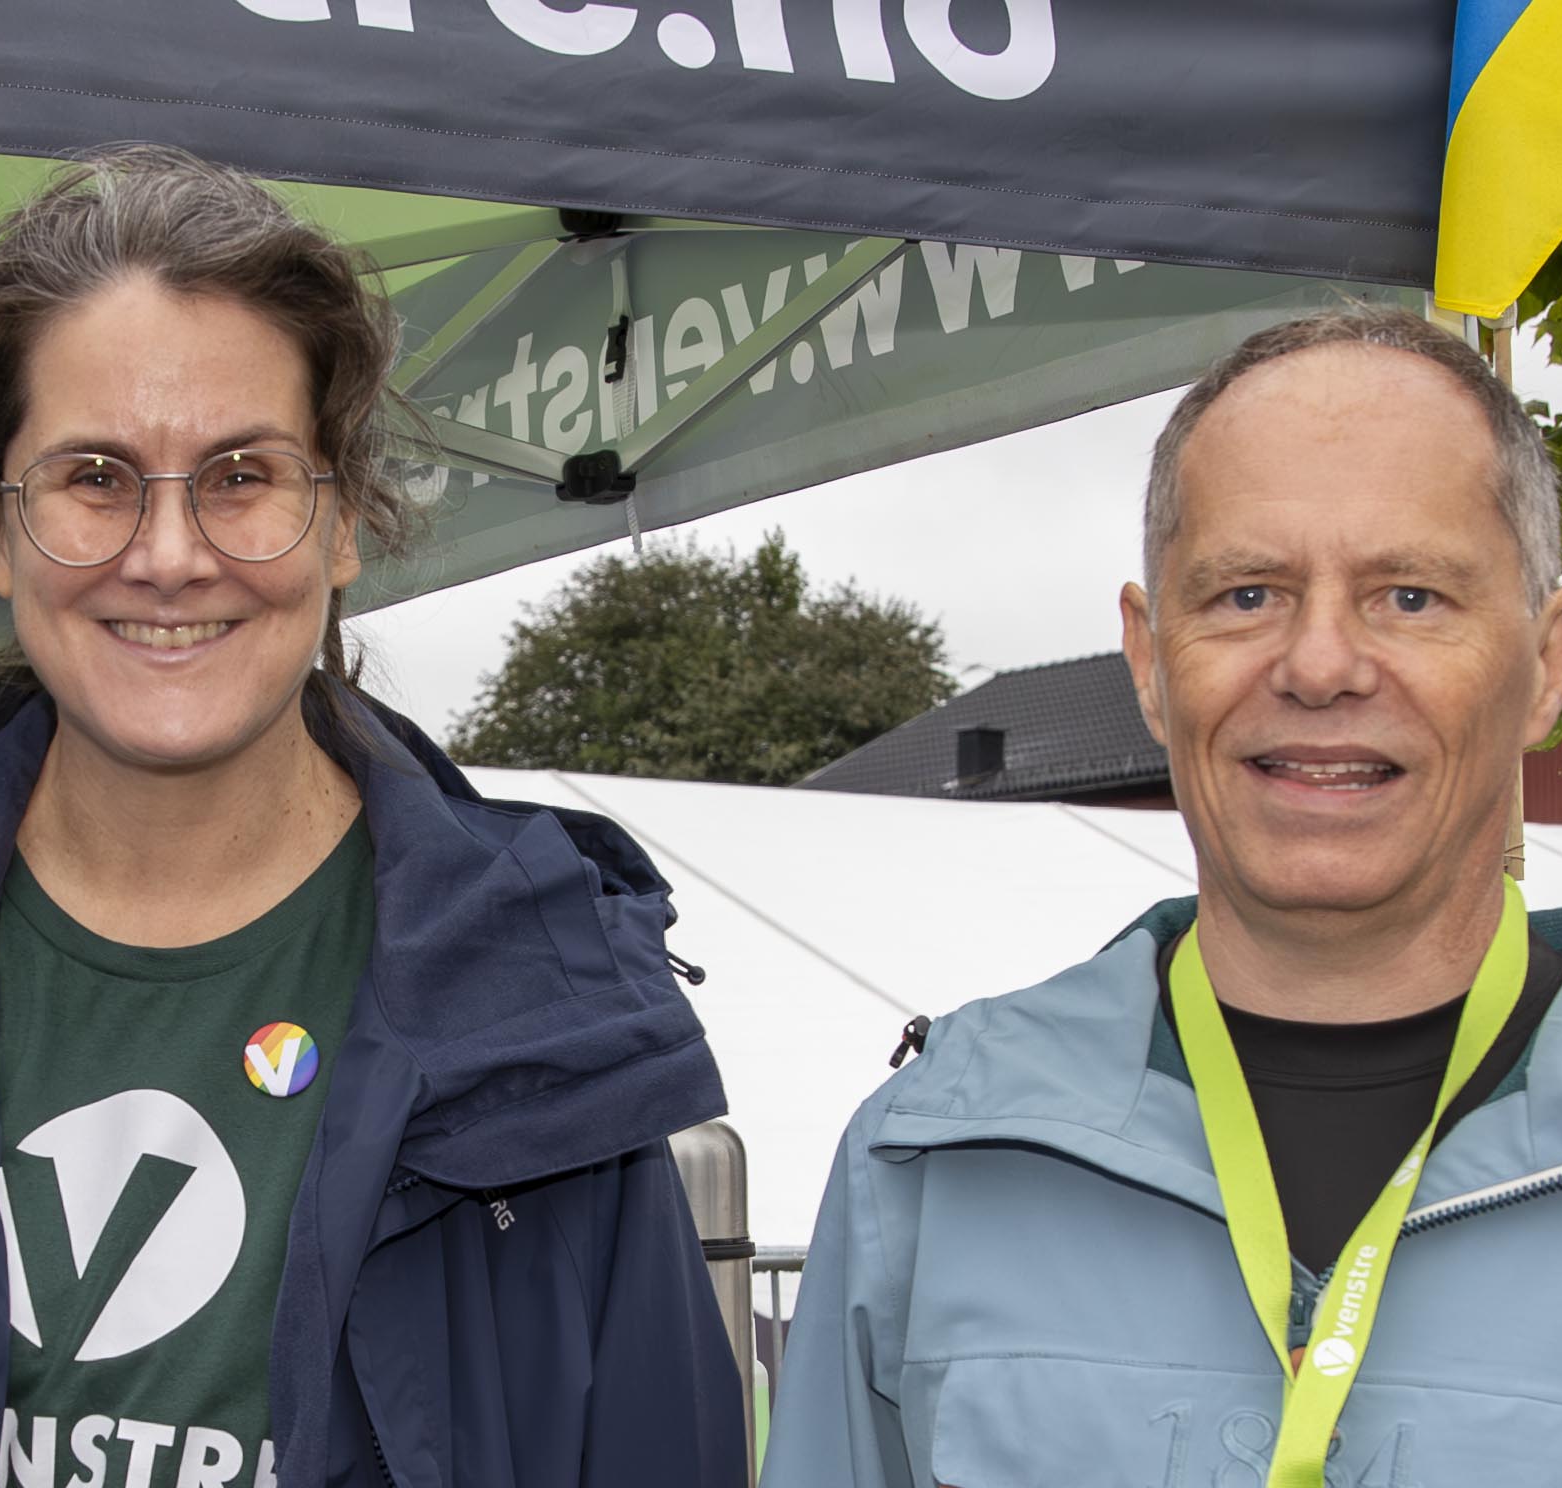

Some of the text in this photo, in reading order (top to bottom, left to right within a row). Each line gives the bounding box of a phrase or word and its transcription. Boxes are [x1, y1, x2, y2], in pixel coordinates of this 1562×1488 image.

[234, 0, 1056, 100] .no
[244, 1036, 301, 1097] V
[1333, 1244, 1379, 1337] venstre
